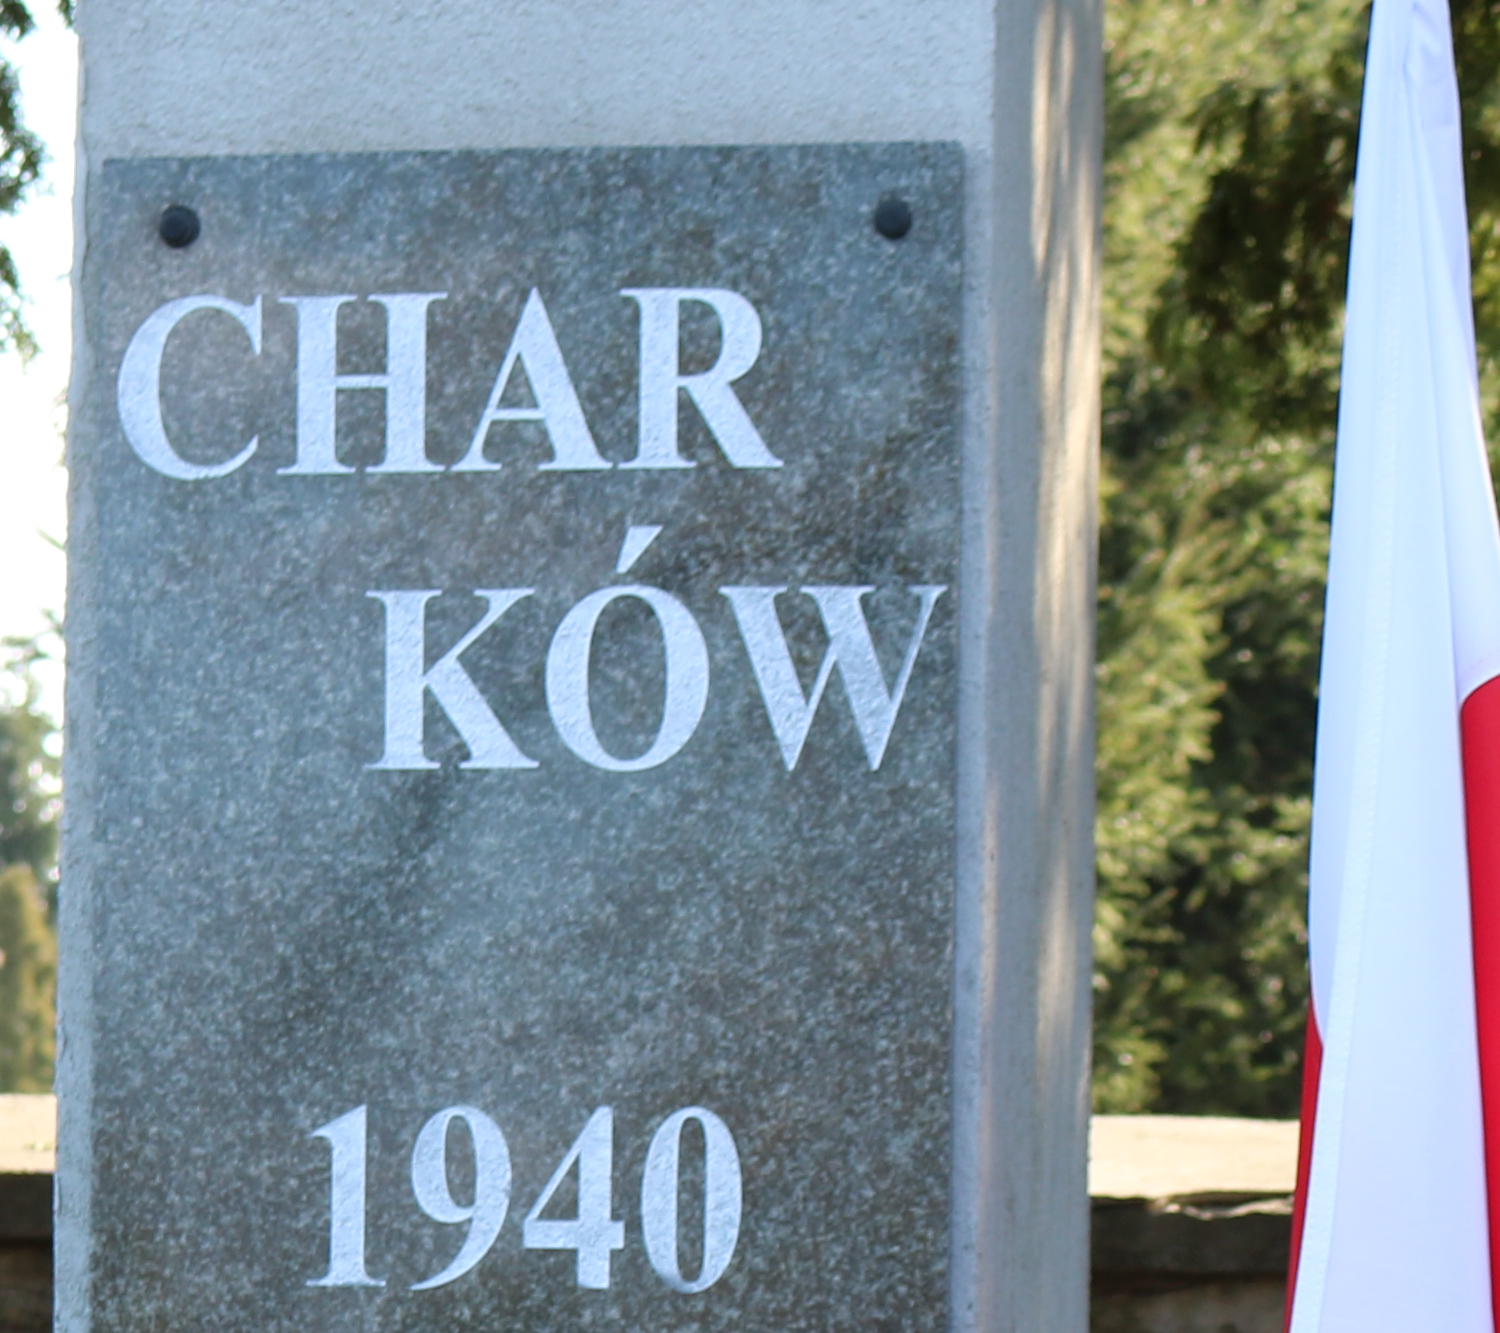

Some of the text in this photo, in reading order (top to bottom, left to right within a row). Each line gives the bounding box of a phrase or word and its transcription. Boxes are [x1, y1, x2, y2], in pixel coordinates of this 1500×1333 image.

[117, 287, 784, 481] CHAR
[366, 525, 948, 772] KÓW
[306, 1104, 744, 1293] 1940
